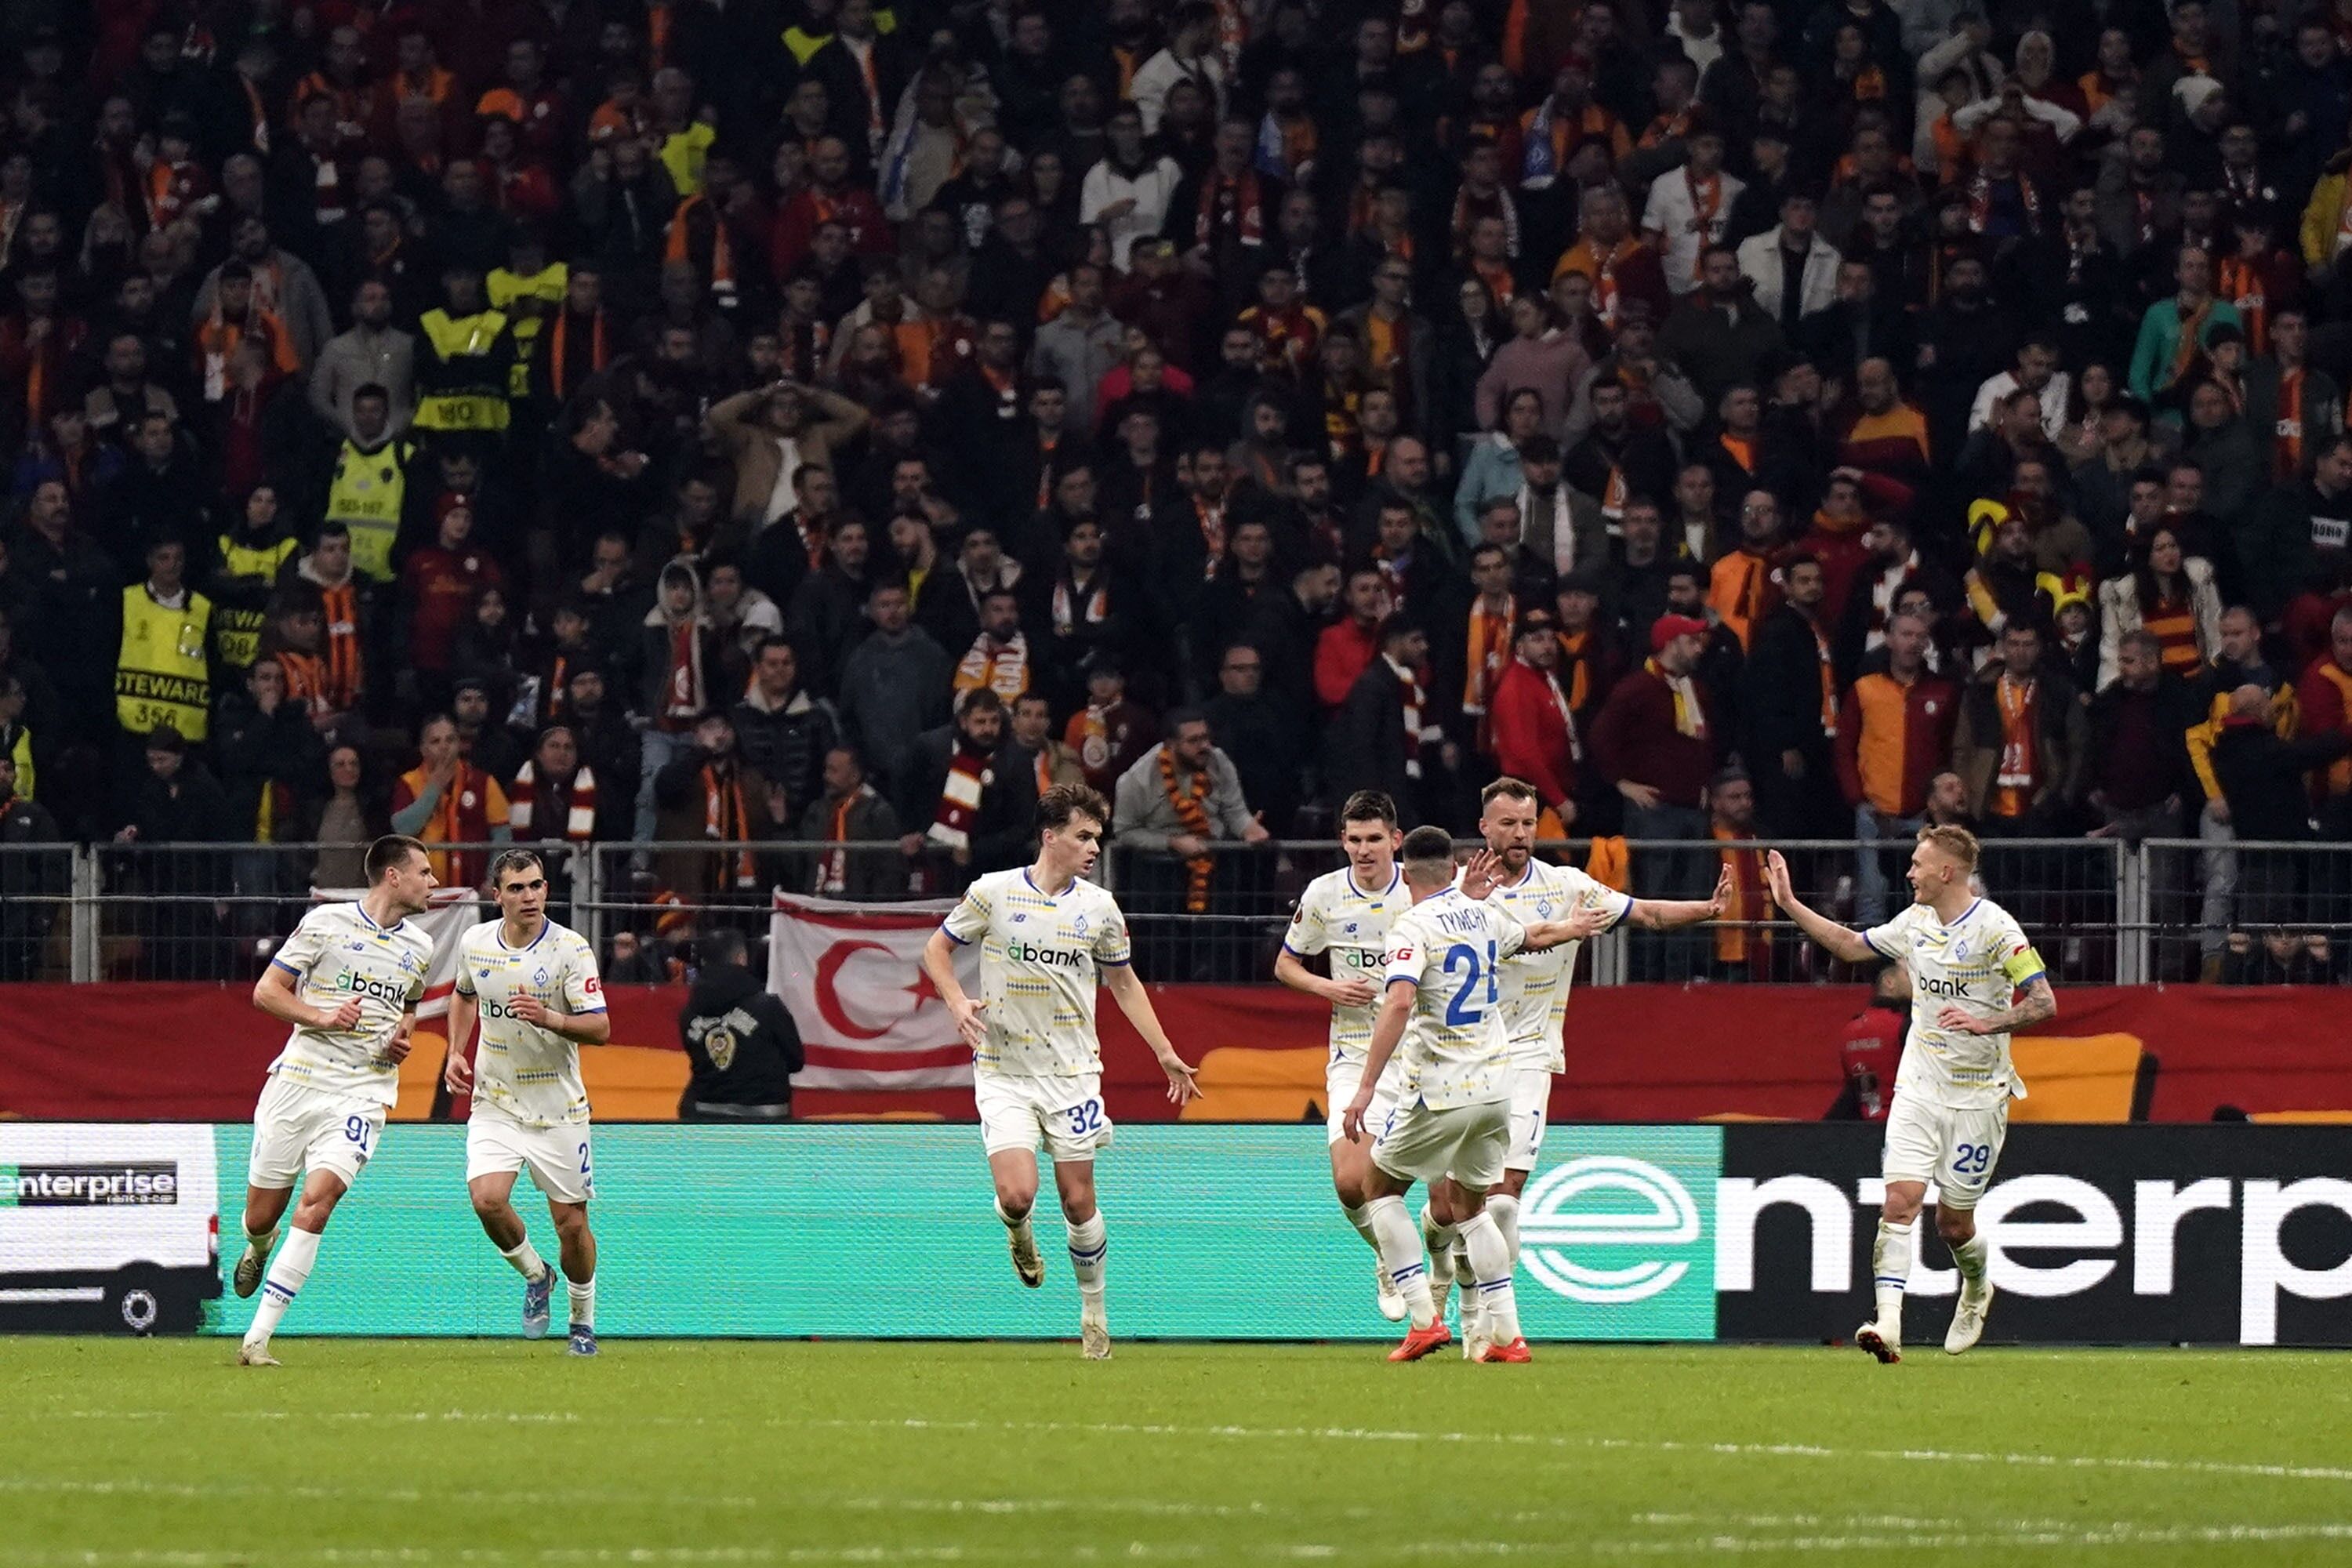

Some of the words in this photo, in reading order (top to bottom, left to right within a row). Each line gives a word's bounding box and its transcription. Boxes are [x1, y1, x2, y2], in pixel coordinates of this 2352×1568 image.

[1443, 940, 1498, 1026] 21
[346, 1116, 369, 1152] 91
[1067, 1099, 1102, 1134] 32
[1953, 1143, 1990, 1174] 29
[0, 1169, 175, 1203] enterprise
